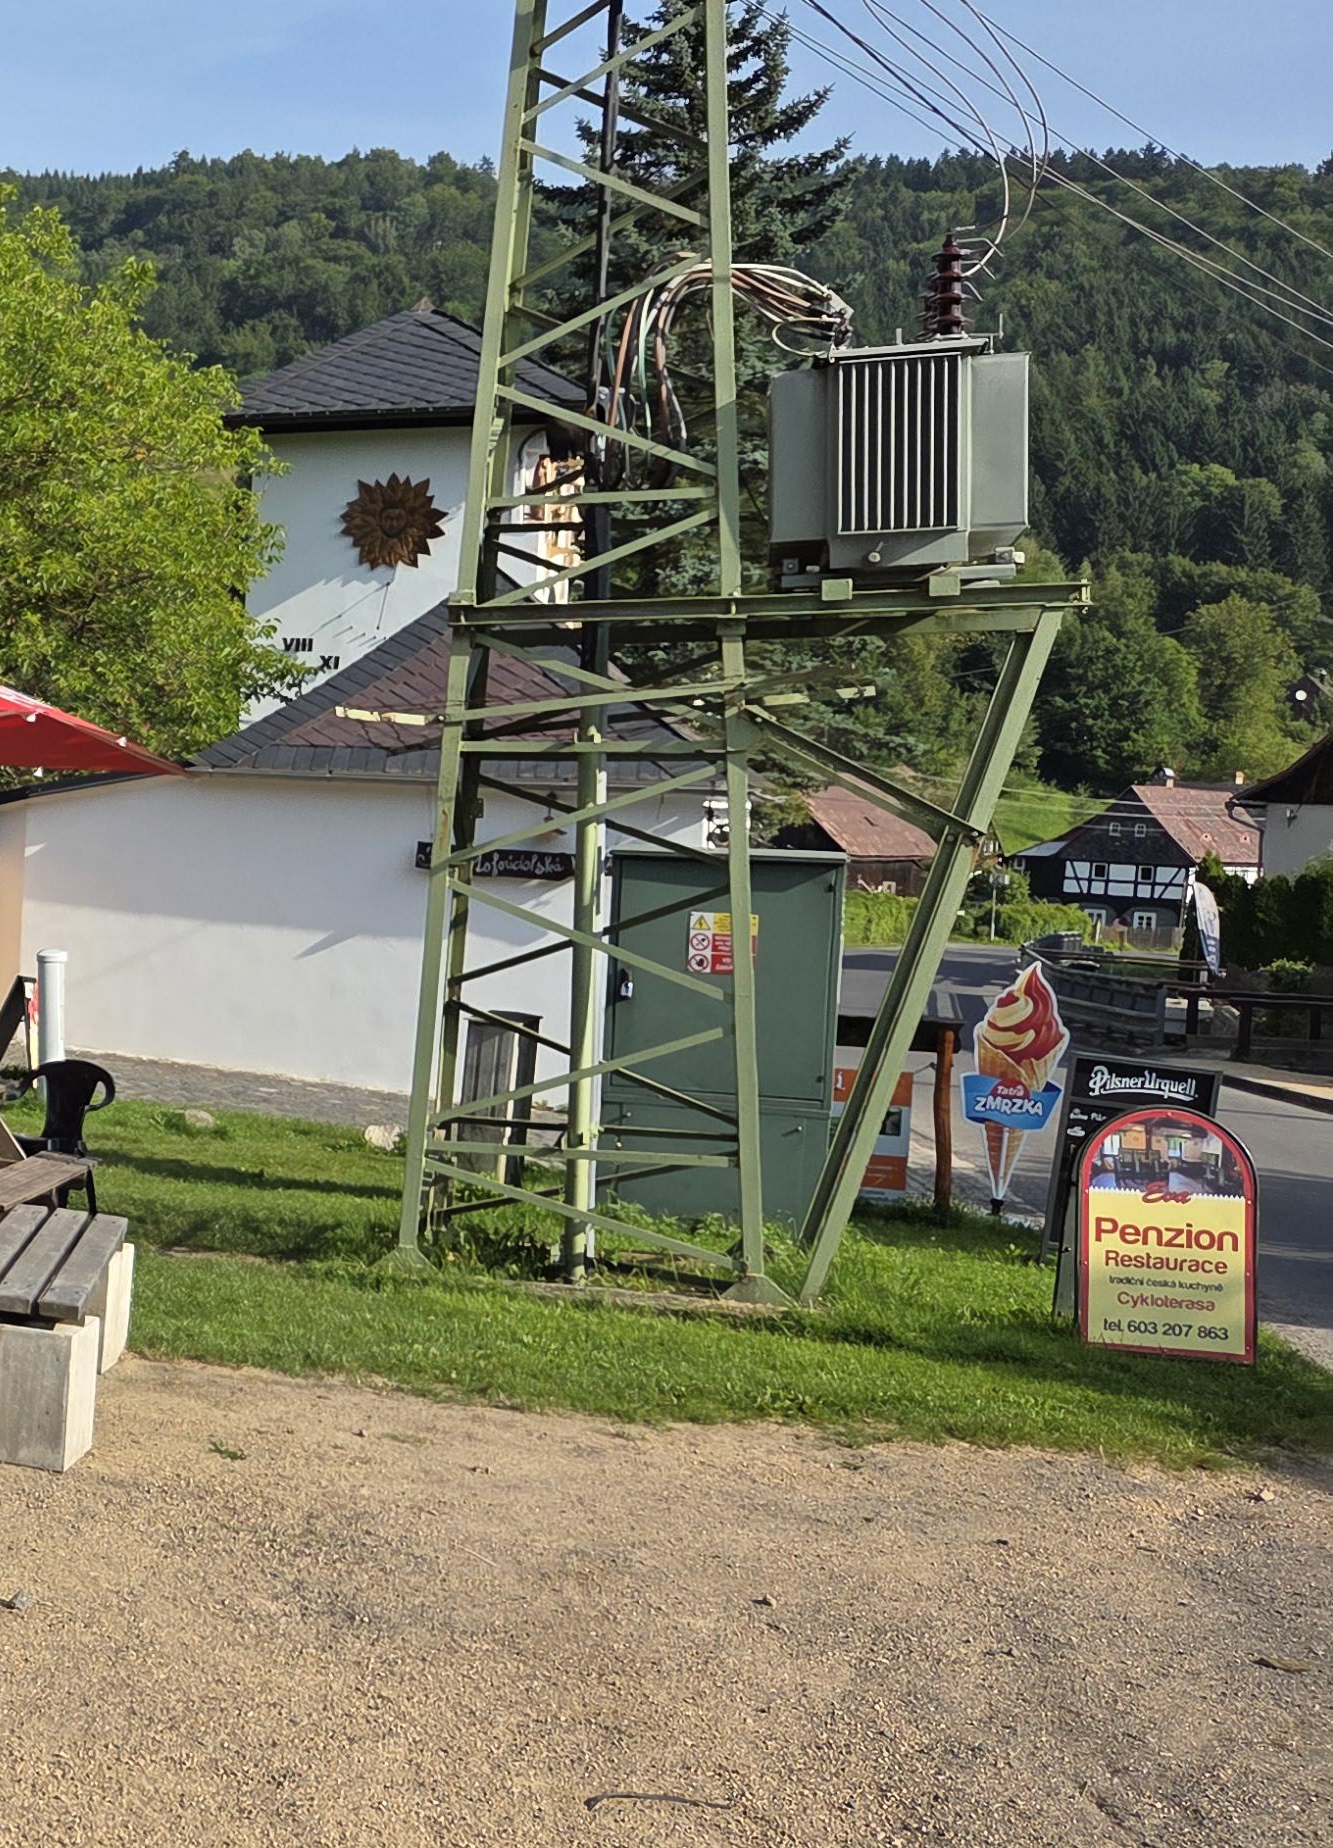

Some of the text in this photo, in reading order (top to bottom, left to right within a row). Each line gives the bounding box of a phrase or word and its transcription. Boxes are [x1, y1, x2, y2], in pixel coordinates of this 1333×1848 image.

[282, 637, 314, 652] VIII
[318, 655, 340, 670] XI
[1088, 1065, 1199, 1100] Pilsner Urquell
[974, 1095, 1043, 1117] ZMRZKA
[1141, 1180, 1192, 1205] Eva
[1094, 1216, 1239, 1253] Penzion
[1104, 1249, 1228, 1275] Restaurace
[1109, 1275, 1223, 1293] tradiční česká kuchyně
[1117, 1291, 1216, 1312] Cykloterasa
[1127, 1320, 1158, 1335] 603
[1162, 1322, 1192, 1337] 207
[1197, 1325, 1229, 1340] 863
